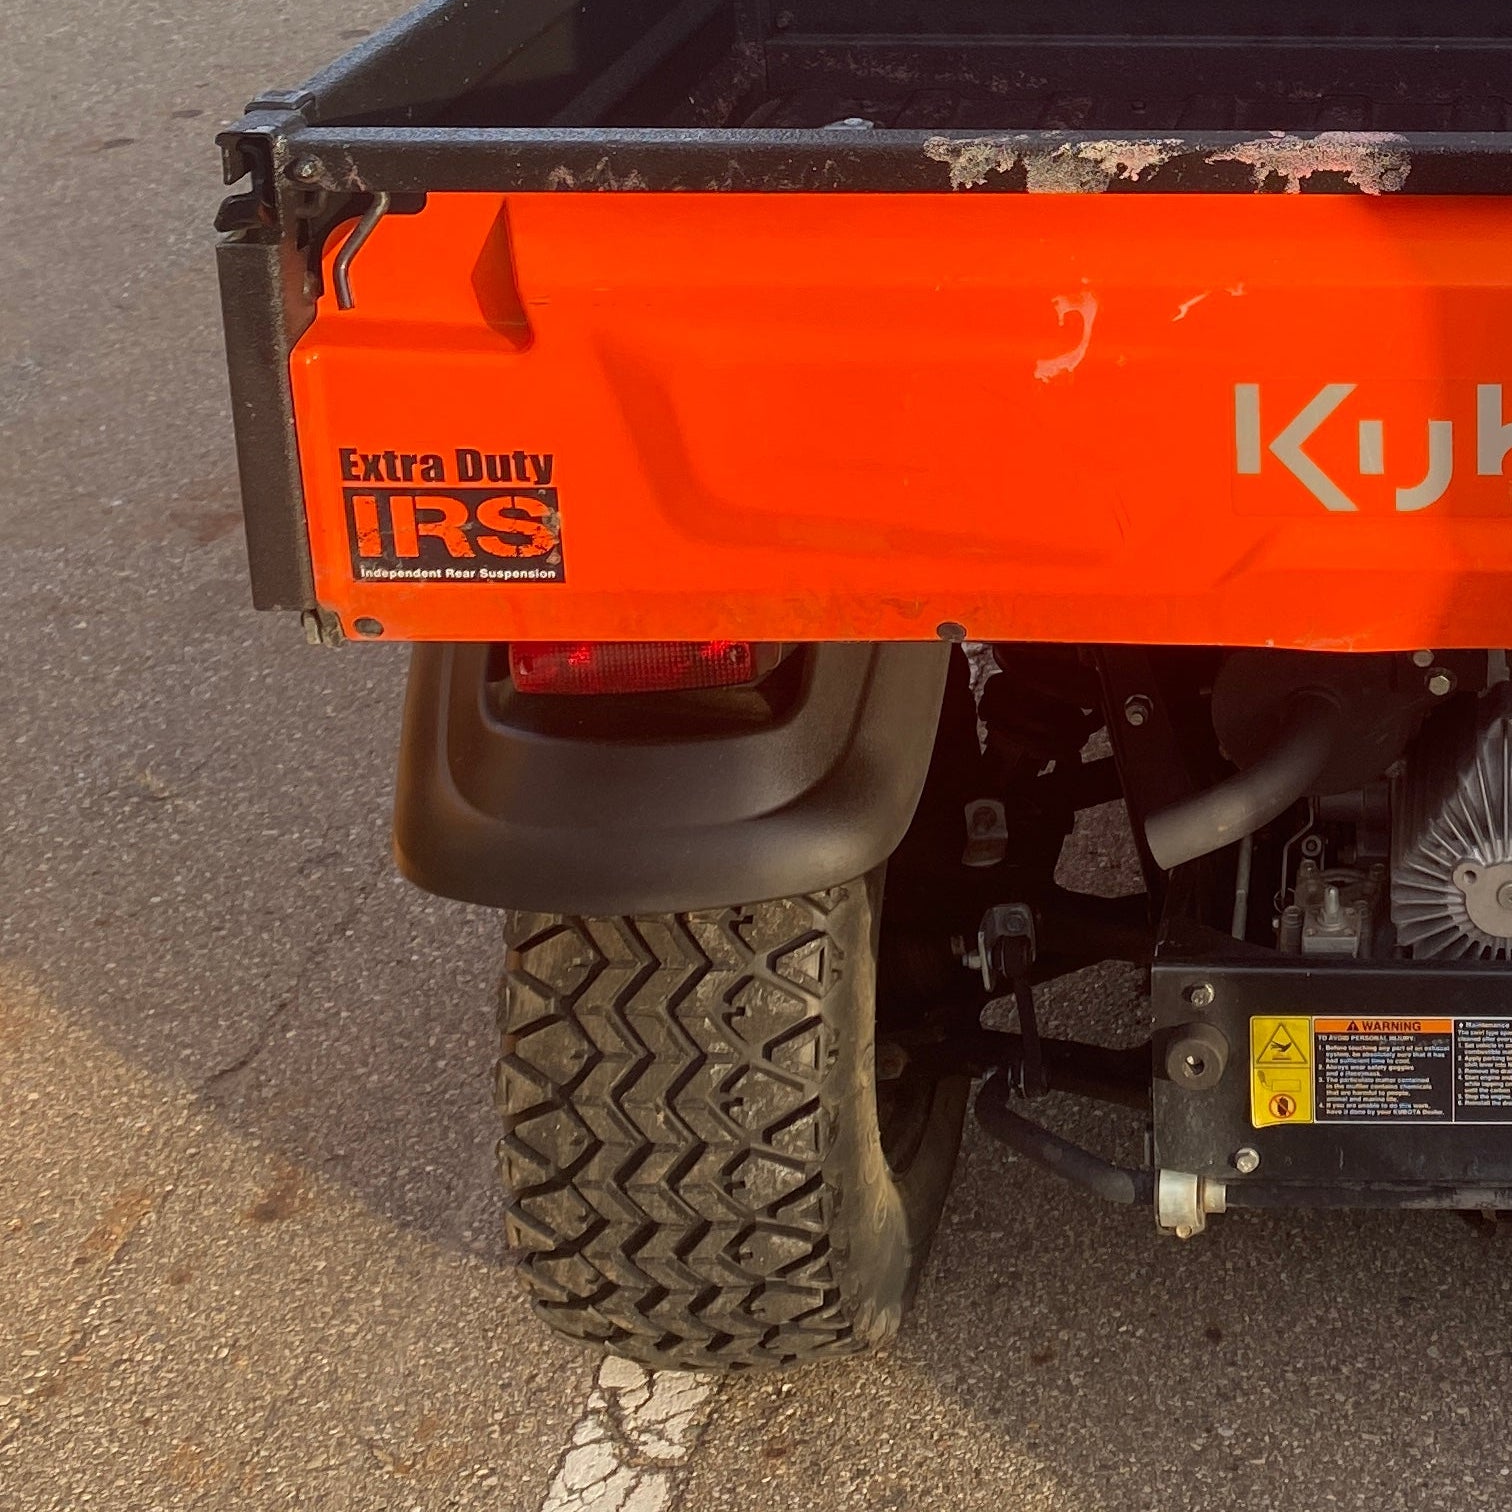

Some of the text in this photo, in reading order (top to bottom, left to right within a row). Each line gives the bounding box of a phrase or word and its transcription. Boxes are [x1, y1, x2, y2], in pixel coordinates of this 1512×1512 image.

[338, 447, 553, 485] Extra Duty
[352, 496, 557, 557] IRS
[360, 568, 556, 581] Independent Rear Suspension
[1362, 1021, 1422, 1031] WARNING
